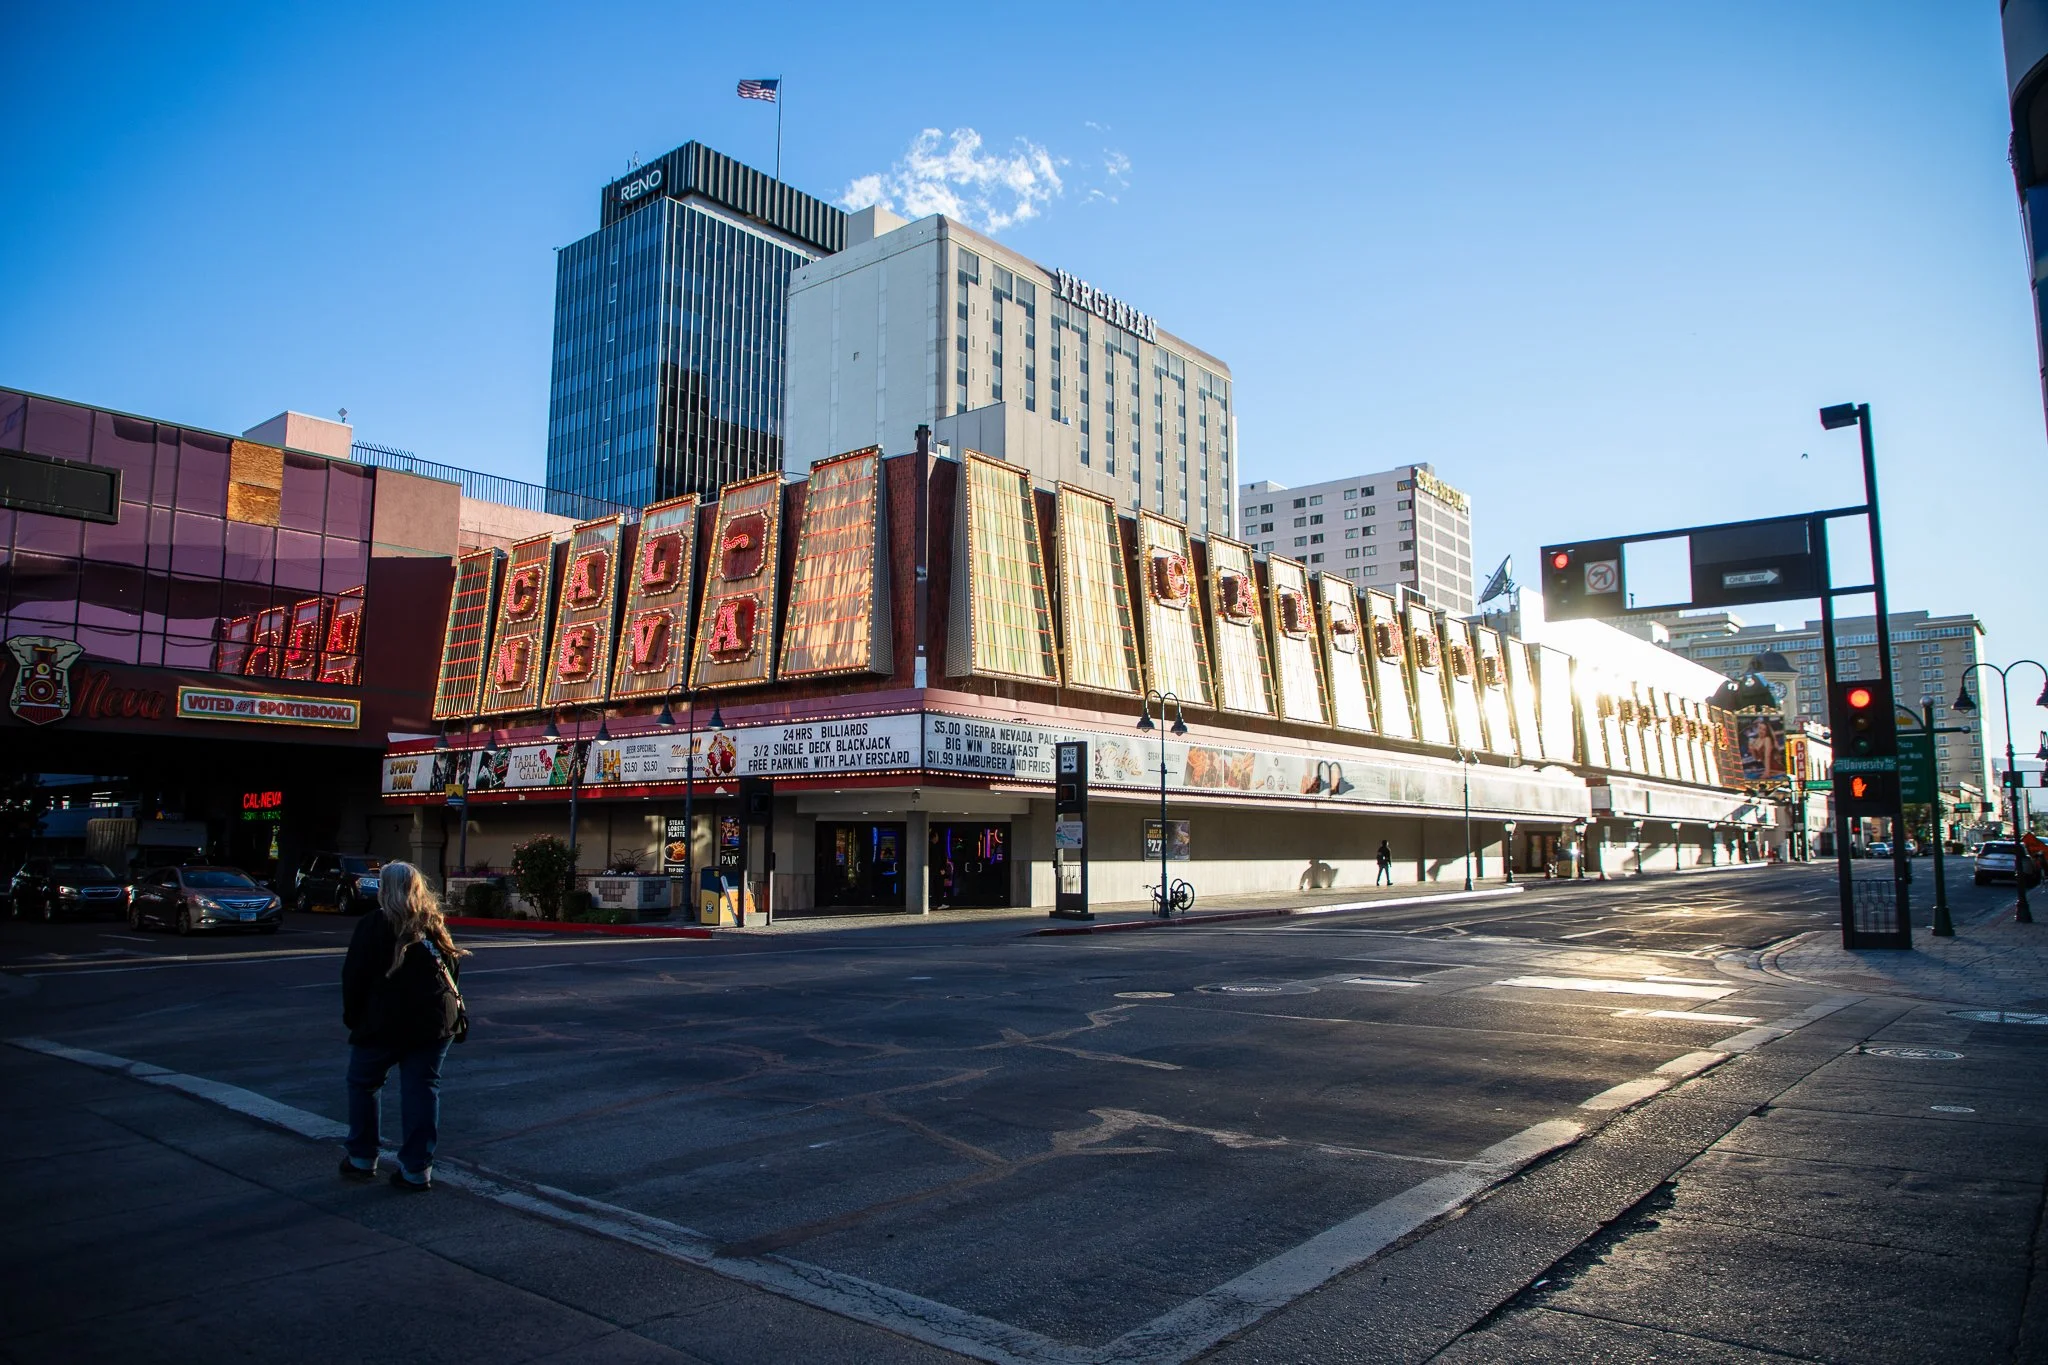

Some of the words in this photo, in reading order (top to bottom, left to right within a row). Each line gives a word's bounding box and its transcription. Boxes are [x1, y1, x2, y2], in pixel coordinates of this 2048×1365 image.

[620, 169, 662, 203] RENO
[1056, 268, 1157, 345] VIRGINIAN
[496, 602, 742, 685] NEVA
[71, 664, 167, 720] Neva
[187, 695, 234, 712] VOTED
[235, 700, 255, 714] #1
[258, 701, 351, 720] SPORTSBOOK!
[821, 723, 868, 738] BILLIARDS
[965, 724, 996, 740] SIERRA
[1000, 728, 1032, 744] NEVADA
[1038, 733, 1058, 746] PALE
[626, 745, 636, 755] BEER
[637, 744, 657, 753] SPECIALS
[753, 744, 769, 757] 3/2
[773, 741, 803, 755] SINGLE
[809, 741, 831, 754] DECK
[836, 737, 891, 751] BLACKJACK
[945, 737, 961, 750] BIG
[966, 739, 983, 753] WIN
[991, 742, 1039, 758] BREAKFAST
[389, 760, 418, 775] SPORTS
[513, 754, 538, 769] TABLE
[624, 762, 637, 773] $3.50
[644, 761, 658, 772] $3.50
[748, 759, 767, 772] FREE
[771, 757, 808, 771] PARKING
[814, 755, 835, 769] WITH
[956, 754, 1007, 770] HAMBURGER
[1009, 759, 1027, 771] AND
[1028, 760, 1051, 773] FRIES
[1844, 759, 1884, 770] University
[392, 775, 414, 790] BOOK
[721, 855, 739, 865] PAR
